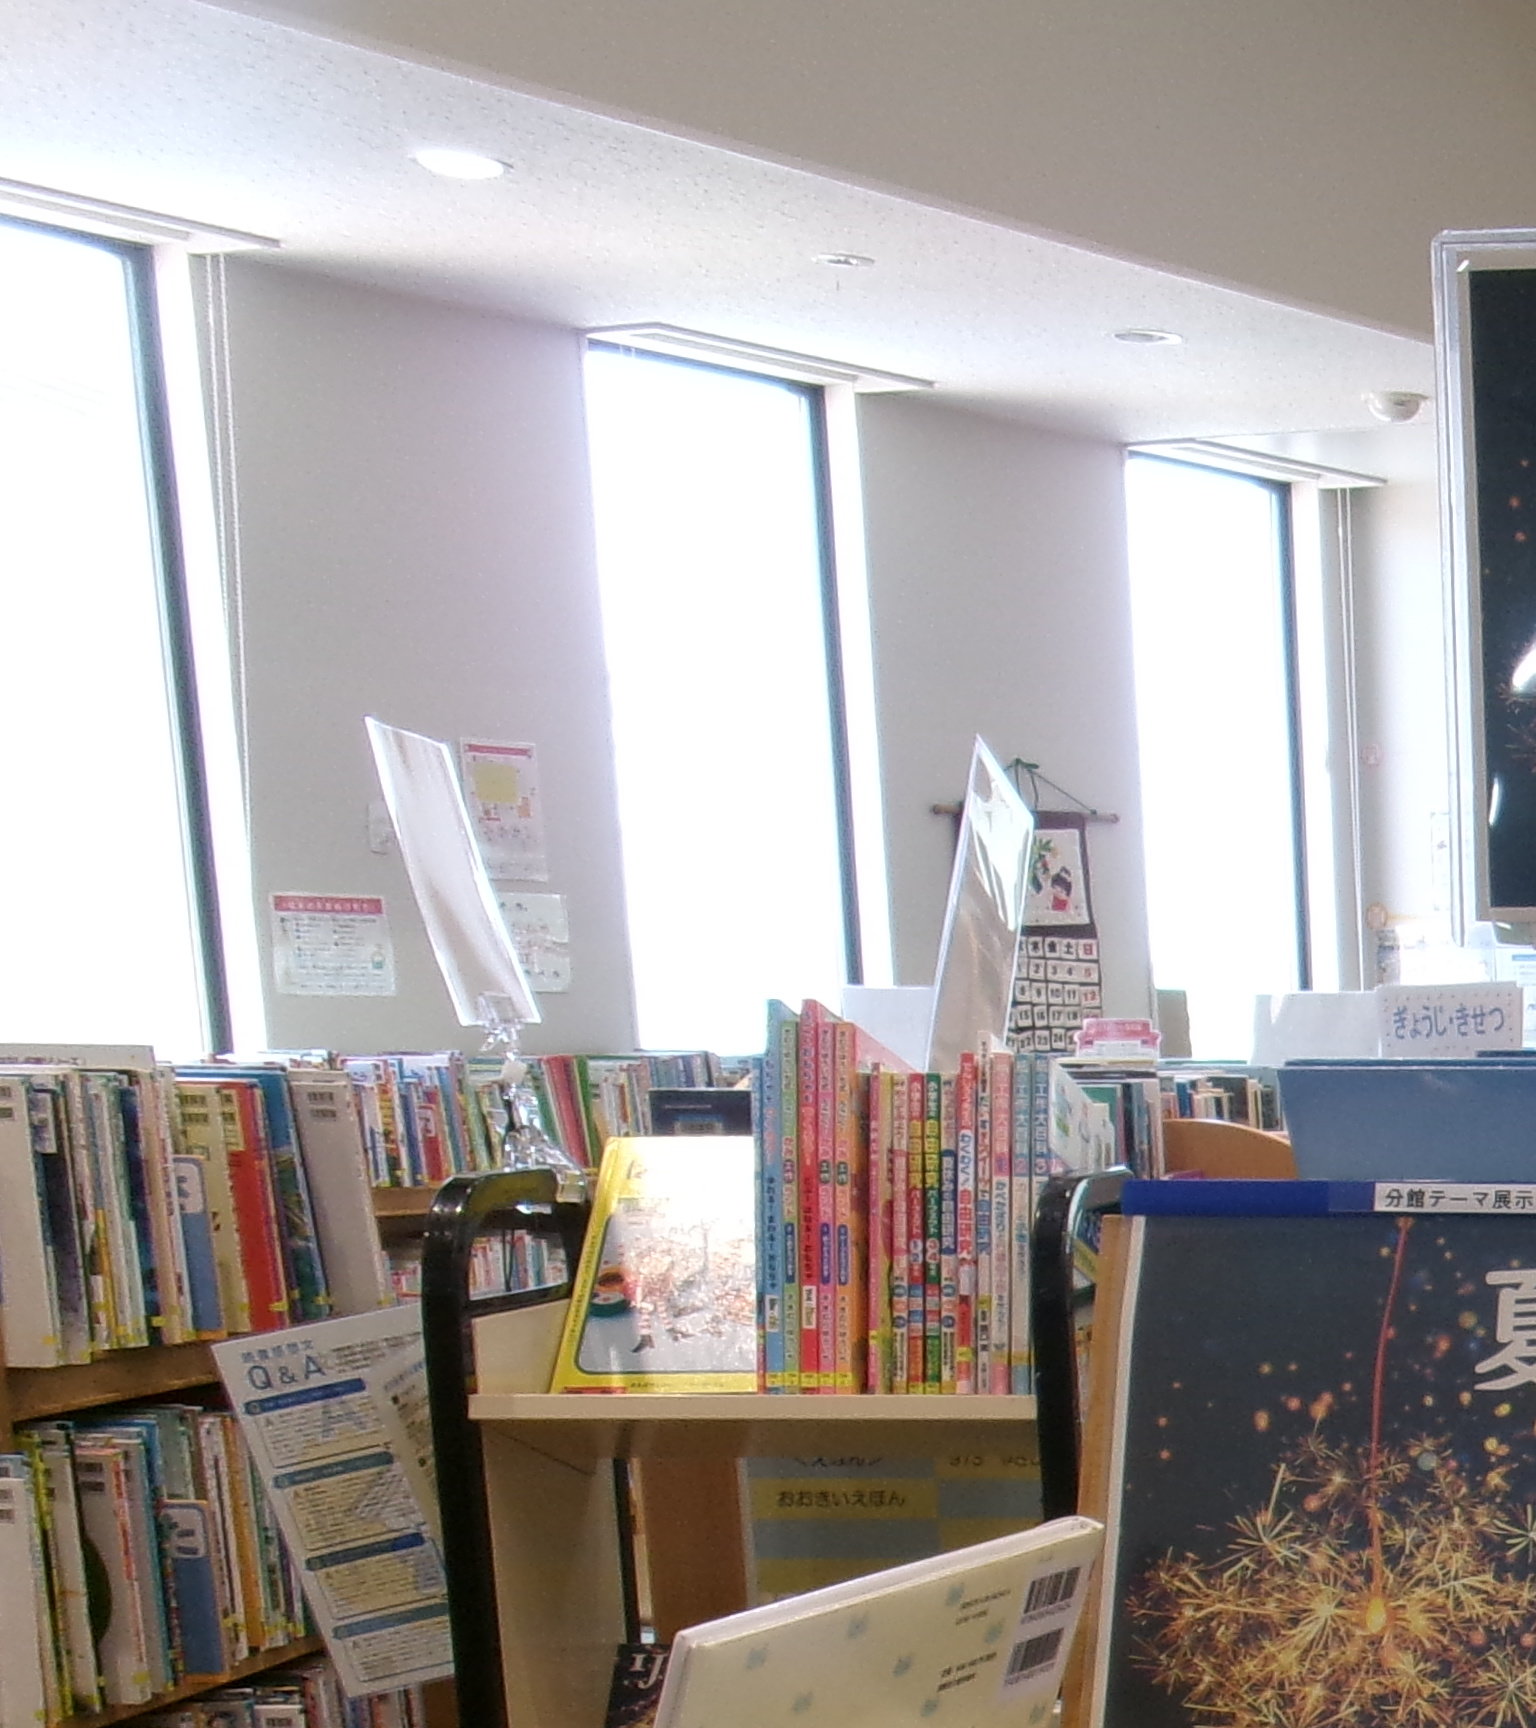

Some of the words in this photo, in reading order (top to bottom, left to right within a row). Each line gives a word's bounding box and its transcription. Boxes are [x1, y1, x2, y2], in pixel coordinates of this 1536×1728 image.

[1394, 1003, 1505, 1038] ぎょうじ・きせつ
